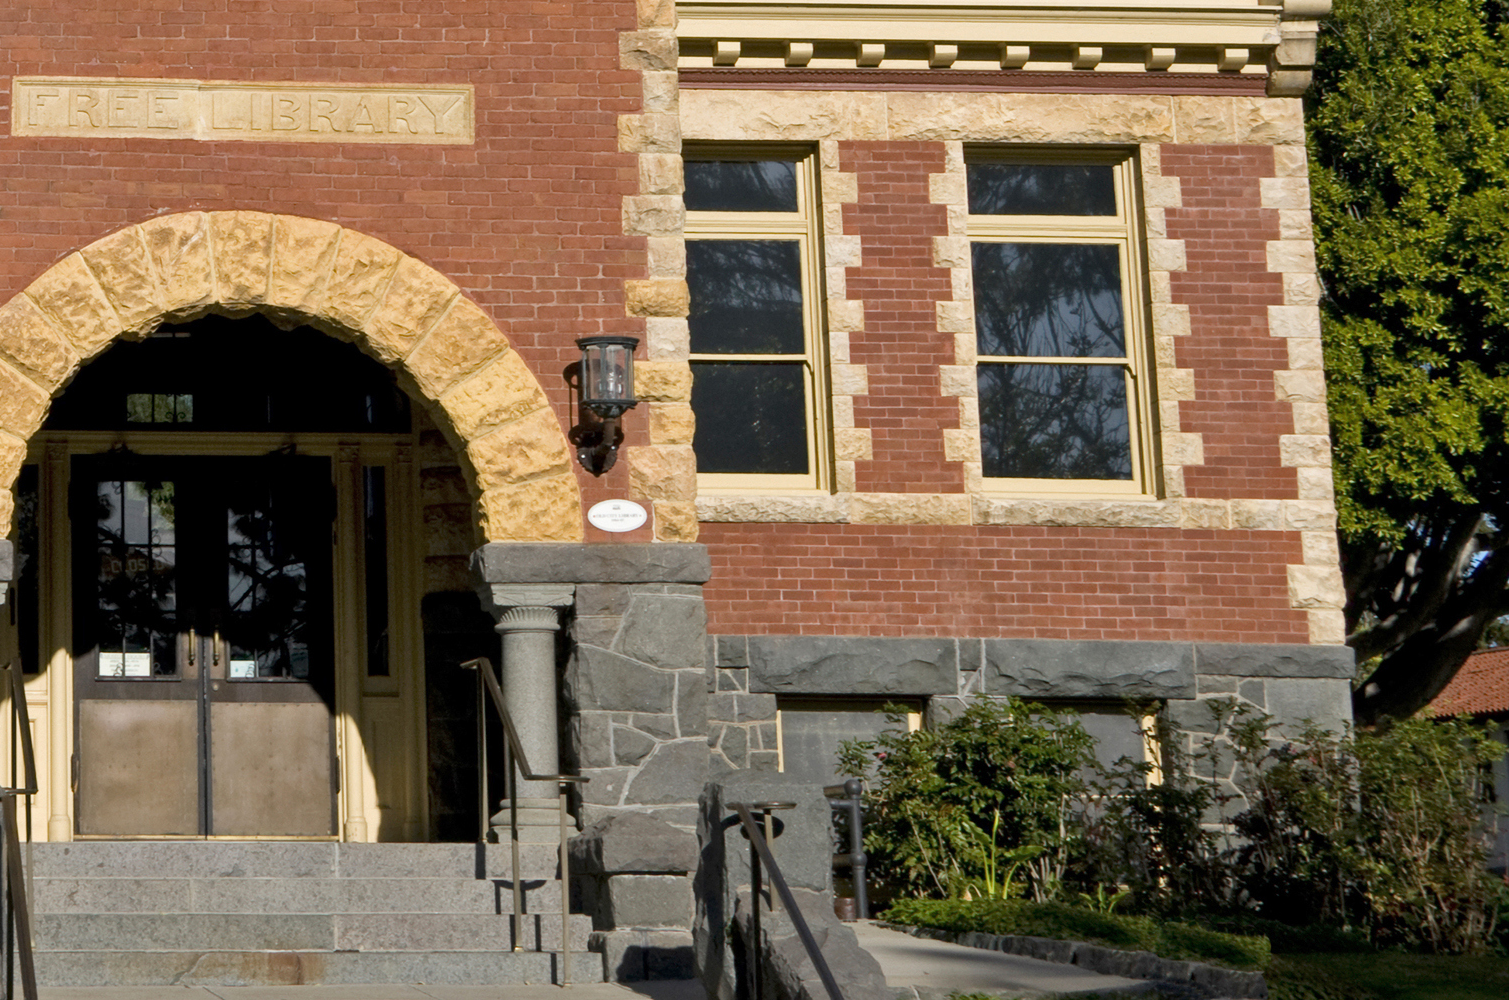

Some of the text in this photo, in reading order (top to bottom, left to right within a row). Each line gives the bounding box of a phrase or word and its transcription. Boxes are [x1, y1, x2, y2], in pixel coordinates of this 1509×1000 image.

[27, 88, 463, 135] FREE LIBRARY
[110, 558, 165, 574] CLOSD
